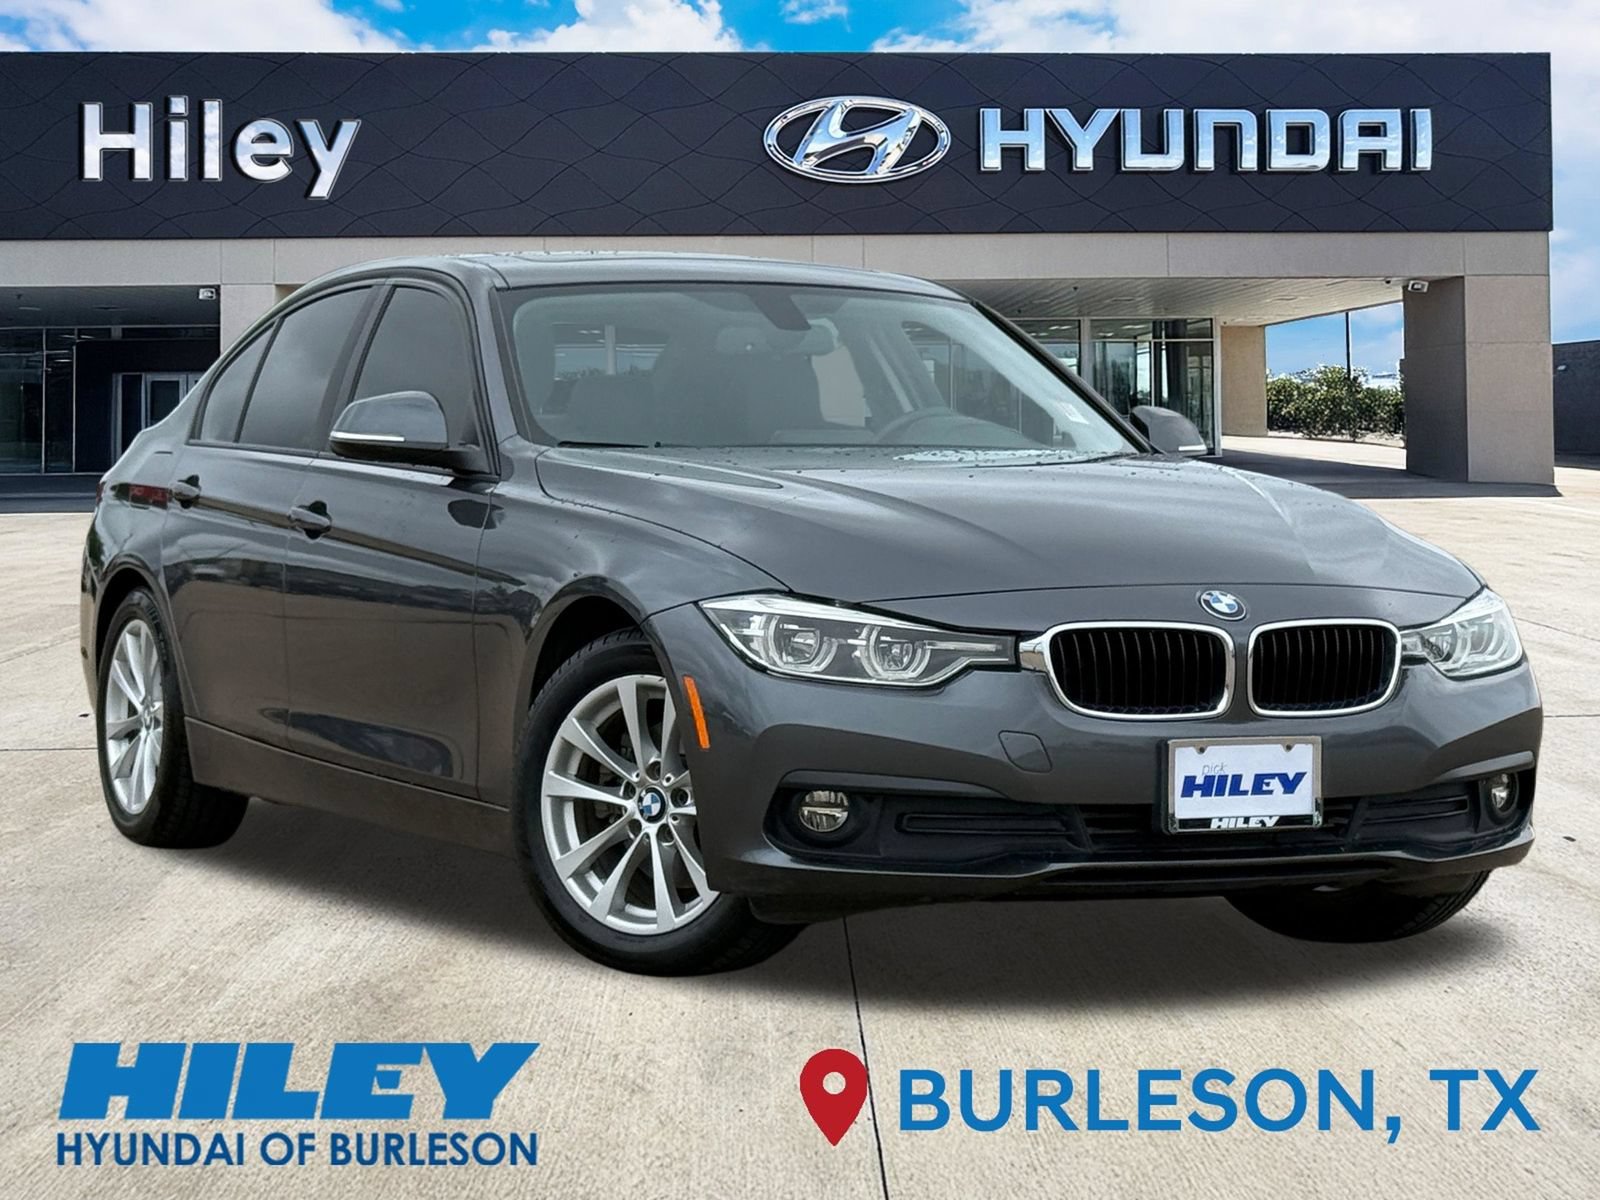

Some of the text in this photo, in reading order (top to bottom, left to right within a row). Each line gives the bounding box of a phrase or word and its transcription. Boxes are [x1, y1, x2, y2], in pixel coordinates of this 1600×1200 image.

[81, 95, 362, 200] Hiley
[979, 108, 1433, 173] HYUNDAI
[1180, 771, 1307, 798] HILEY
[1210, 815, 1280, 829] HILEY
